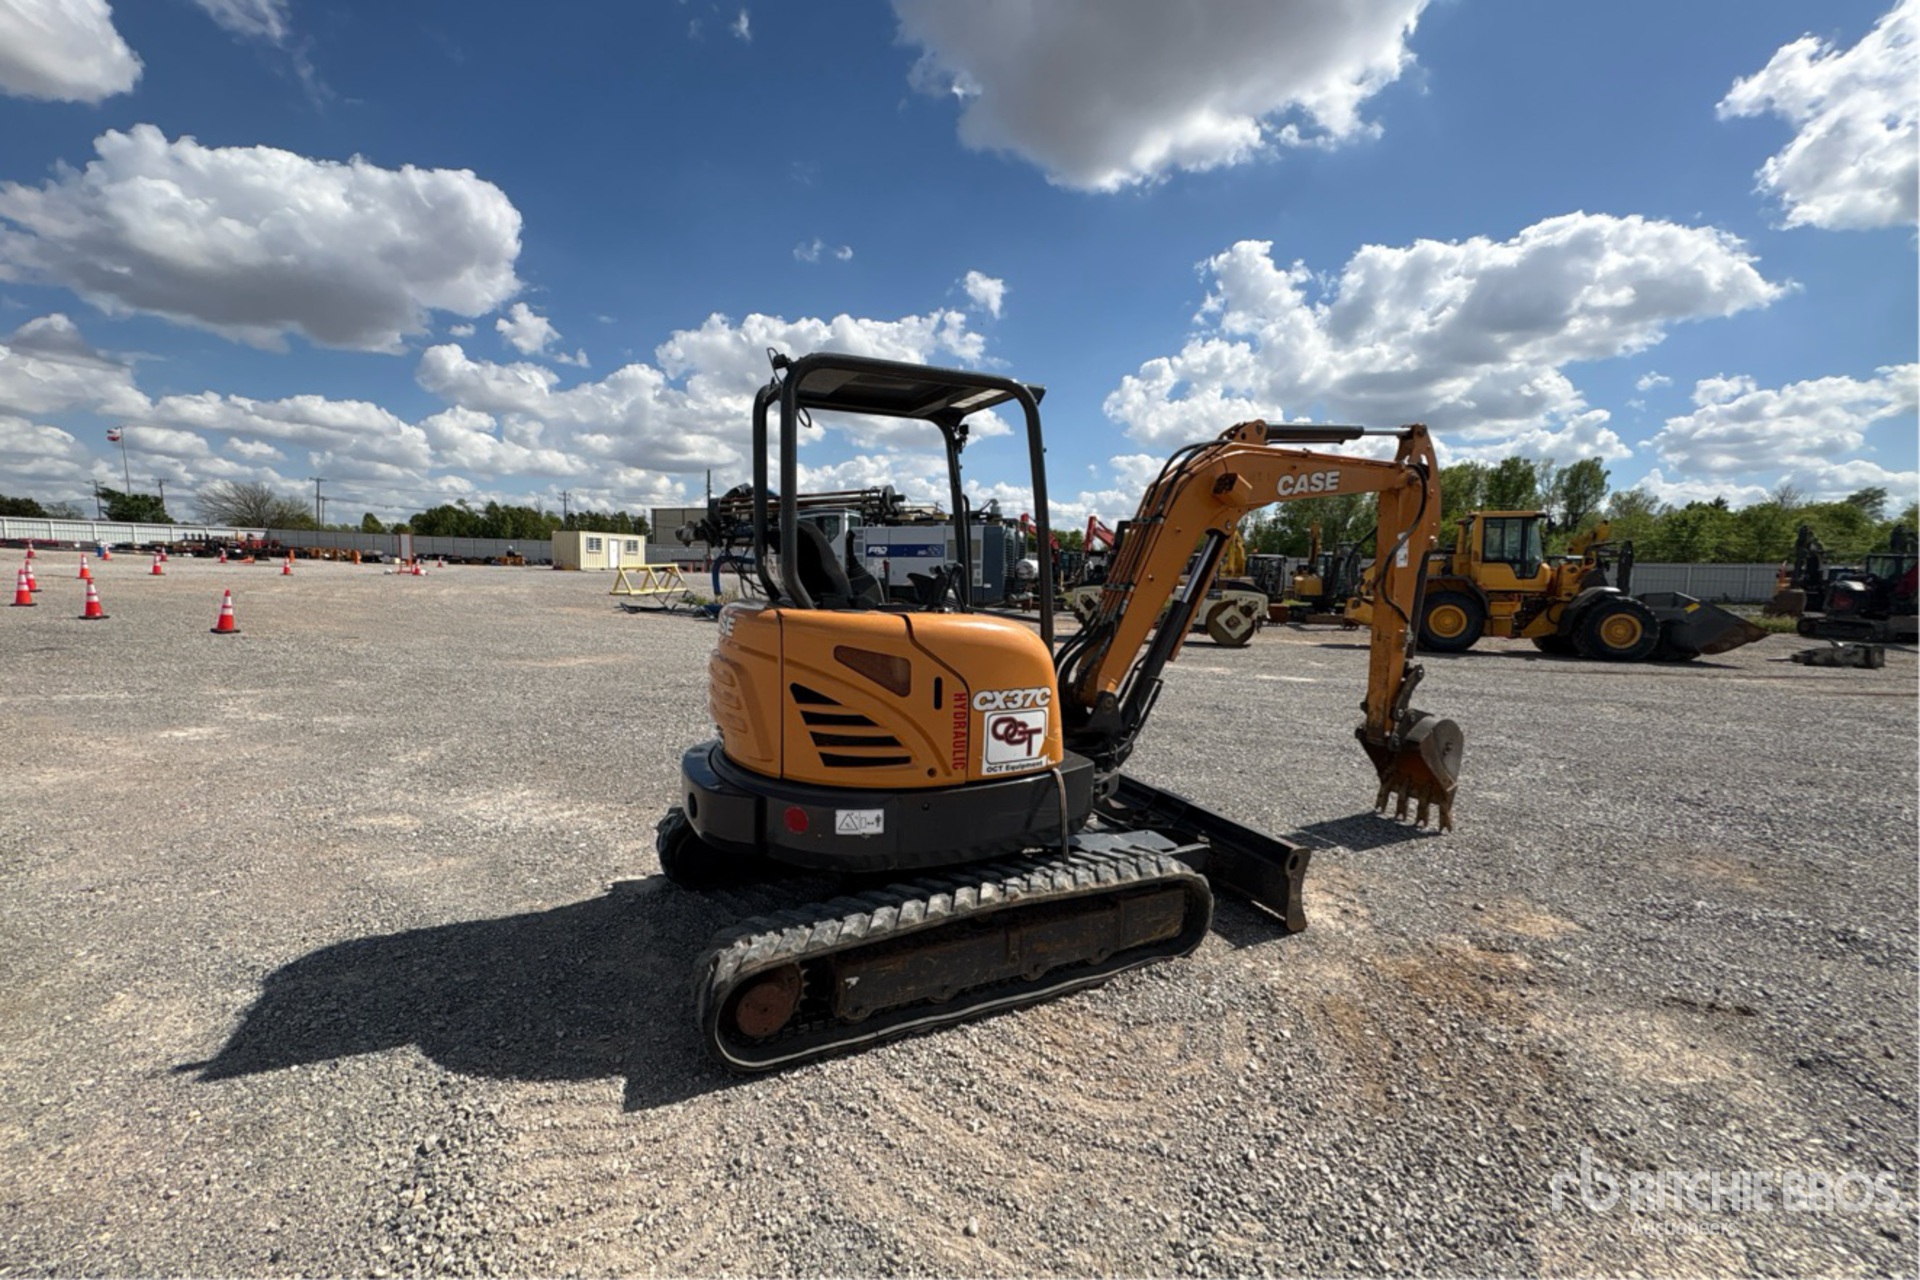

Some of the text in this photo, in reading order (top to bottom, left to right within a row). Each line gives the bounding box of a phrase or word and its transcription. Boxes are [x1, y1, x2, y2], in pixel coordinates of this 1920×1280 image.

[1278, 471, 1340, 496] CASE
[720, 614, 736, 637] SE
[971, 687, 1052, 711] CX37C
[952, 692, 967, 770] HYDRAULIC
[986, 760, 1043, 774] OCT Equipment
